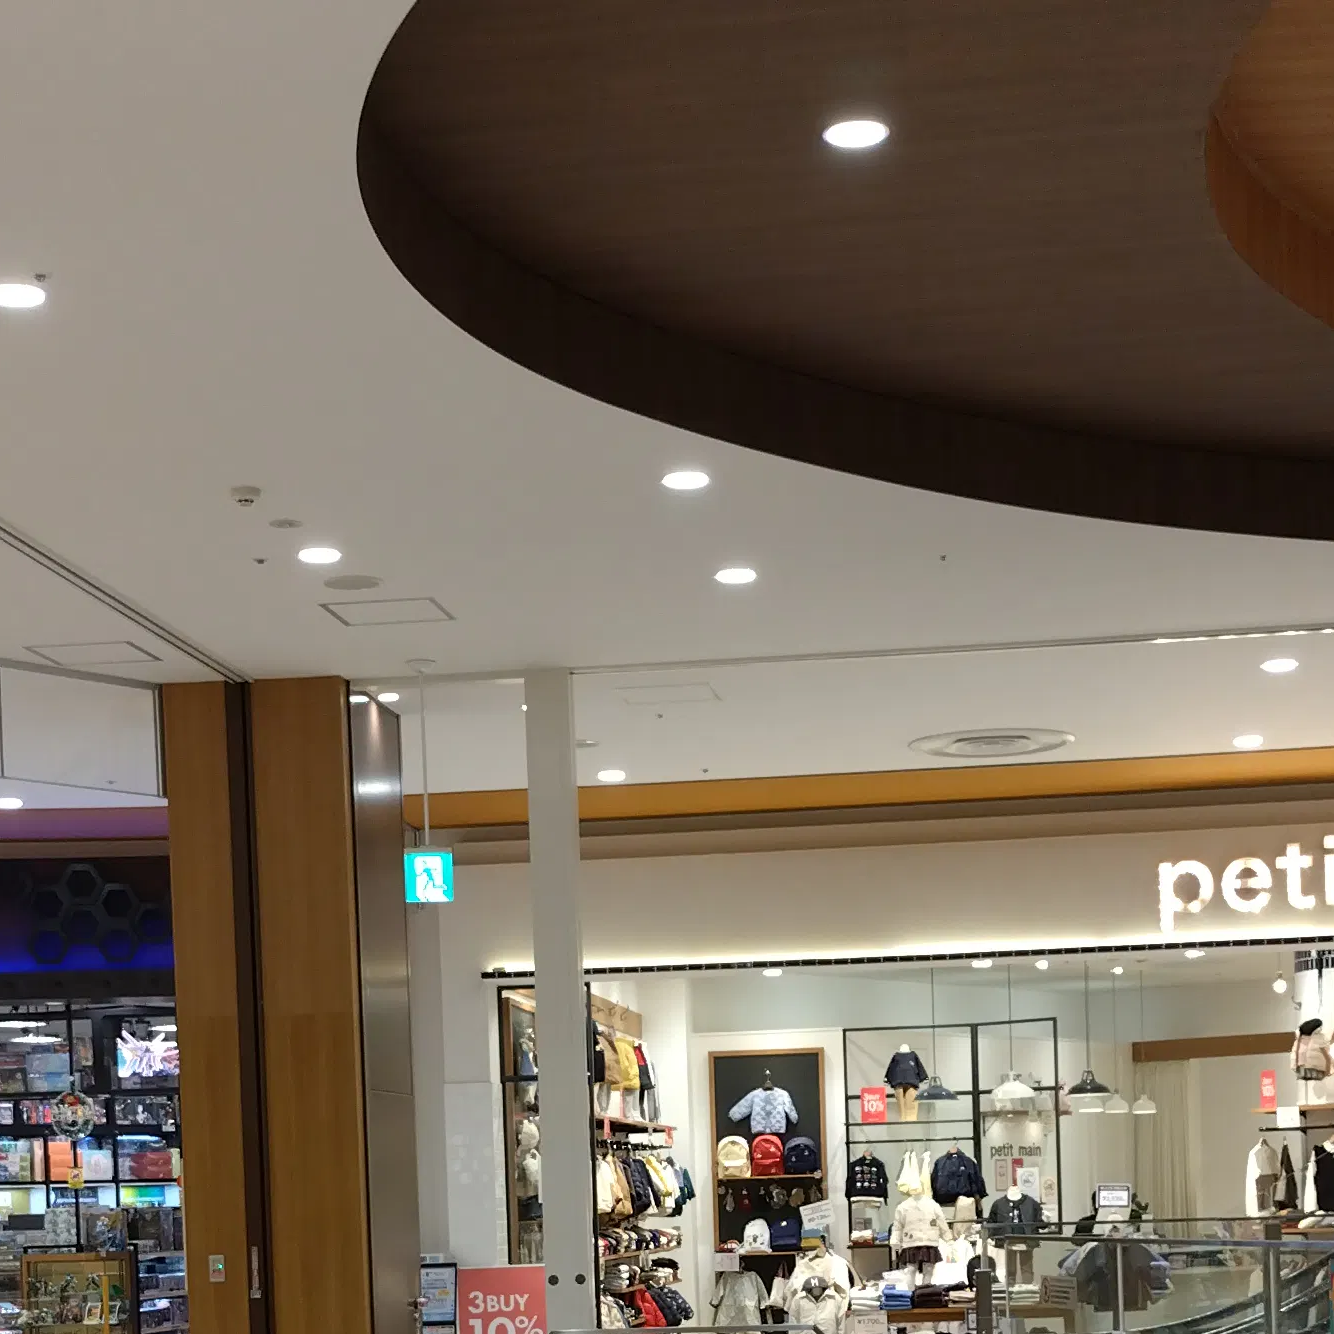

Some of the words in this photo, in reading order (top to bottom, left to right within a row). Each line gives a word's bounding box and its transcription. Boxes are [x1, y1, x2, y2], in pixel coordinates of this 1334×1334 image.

[990, 1143, 1014, 1159] petit
[1018, 1142, 1042, 1157] main
[468, 1291, 529, 1314] 3BUY
